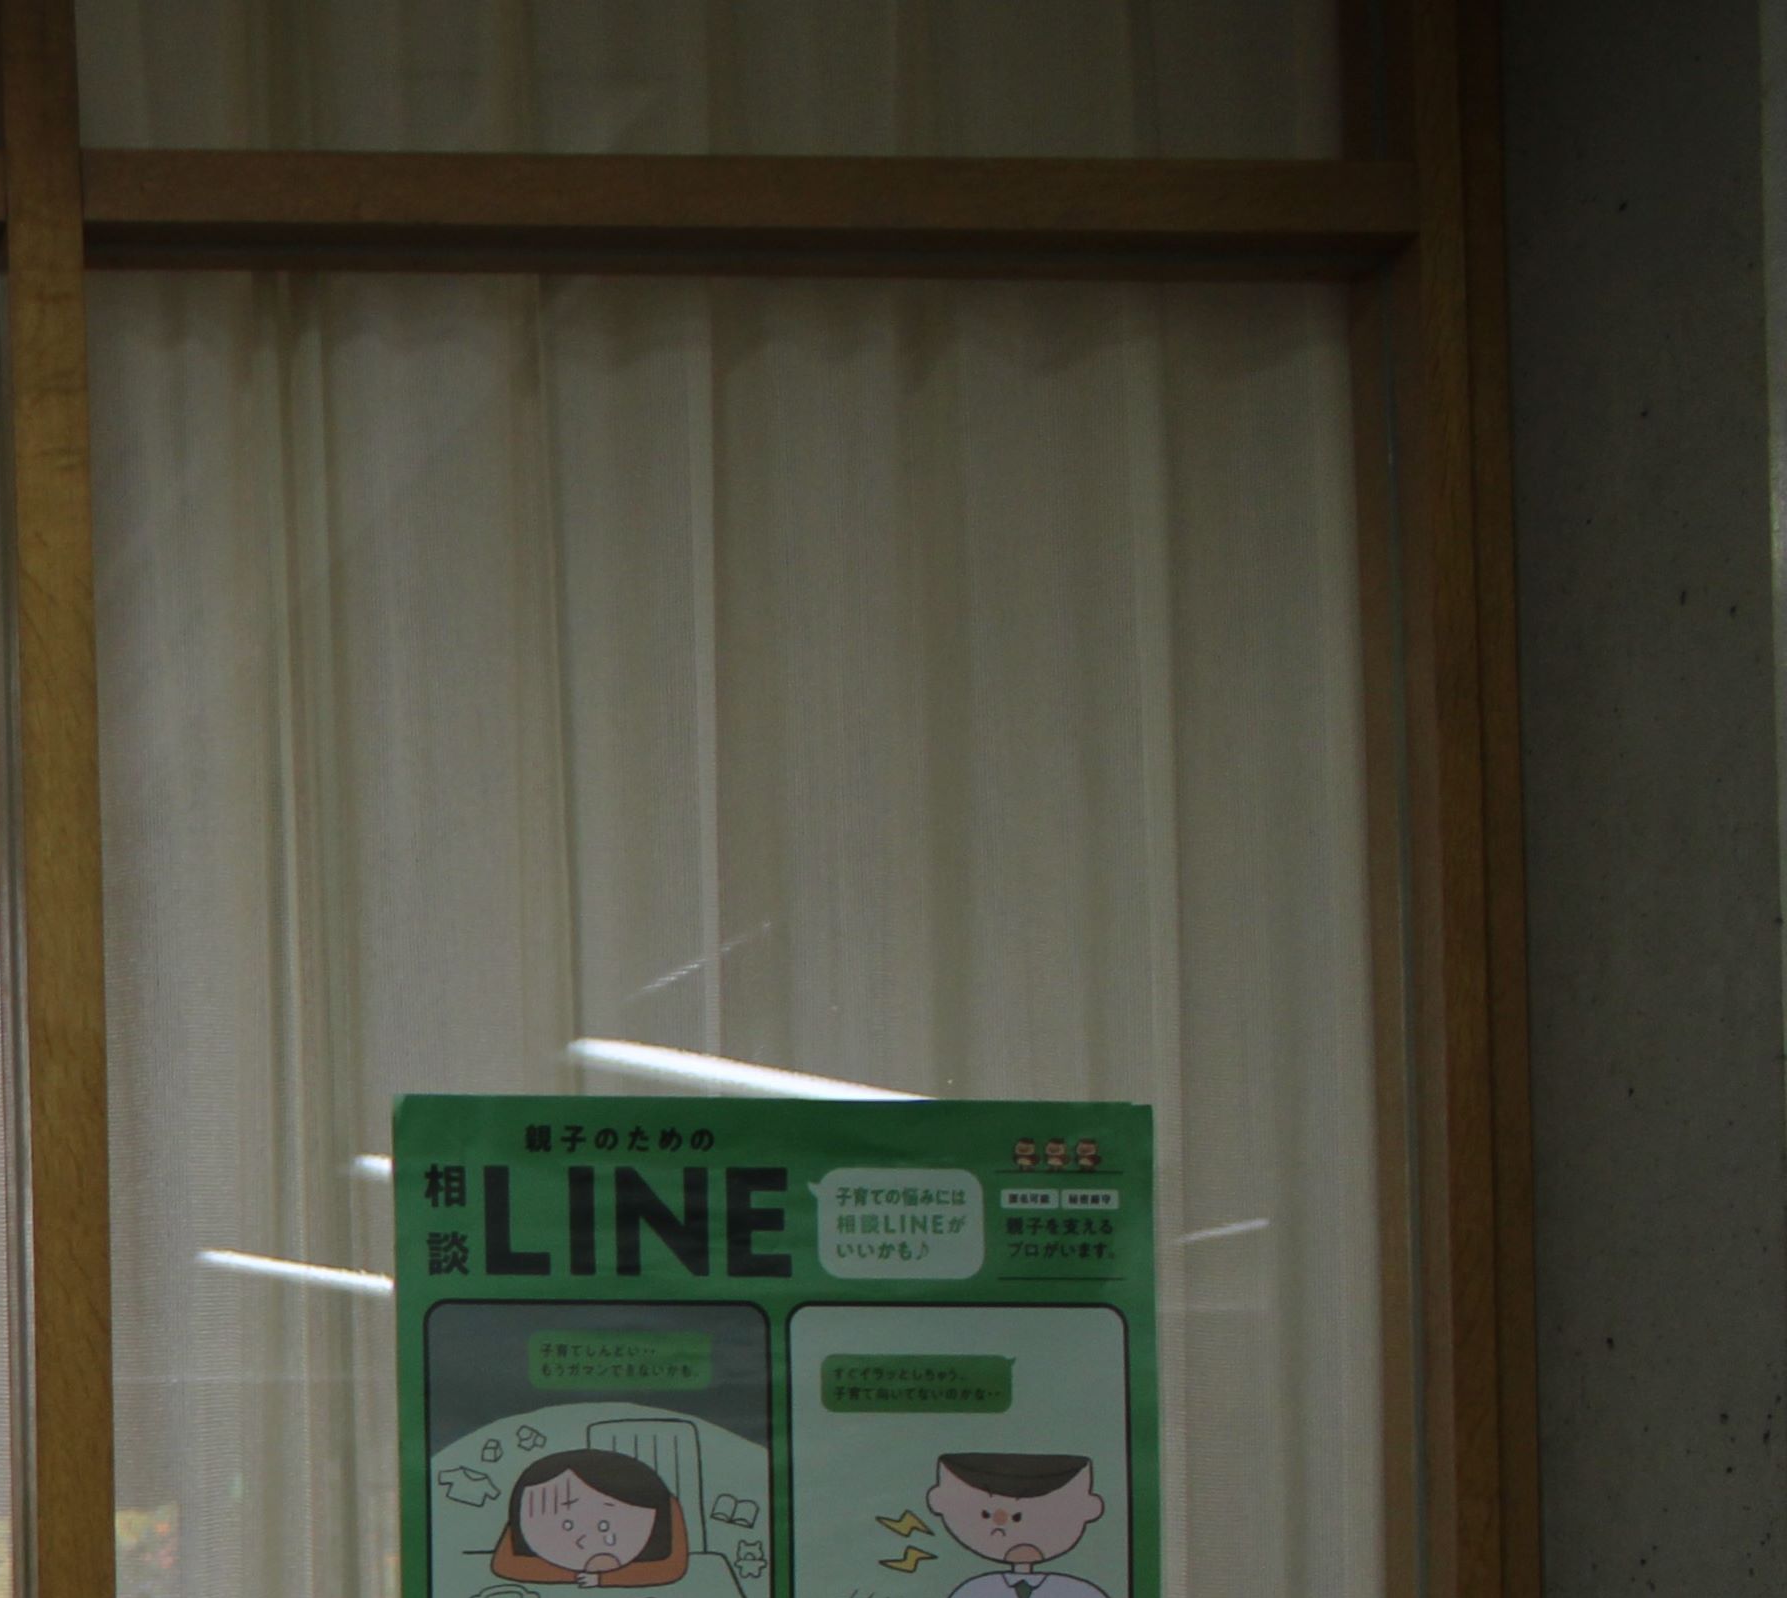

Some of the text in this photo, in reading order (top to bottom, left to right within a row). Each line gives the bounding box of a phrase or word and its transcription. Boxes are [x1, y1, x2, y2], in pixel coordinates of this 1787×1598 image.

[525, 1124, 716, 1152] 親子のための
[835, 1186, 967, 1207] 子育ての悩みには
[425, 1163, 470, 1276] 相談
[483, 1164, 793, 1278] LINE
[836, 1214, 967, 1235] 相談LINEが
